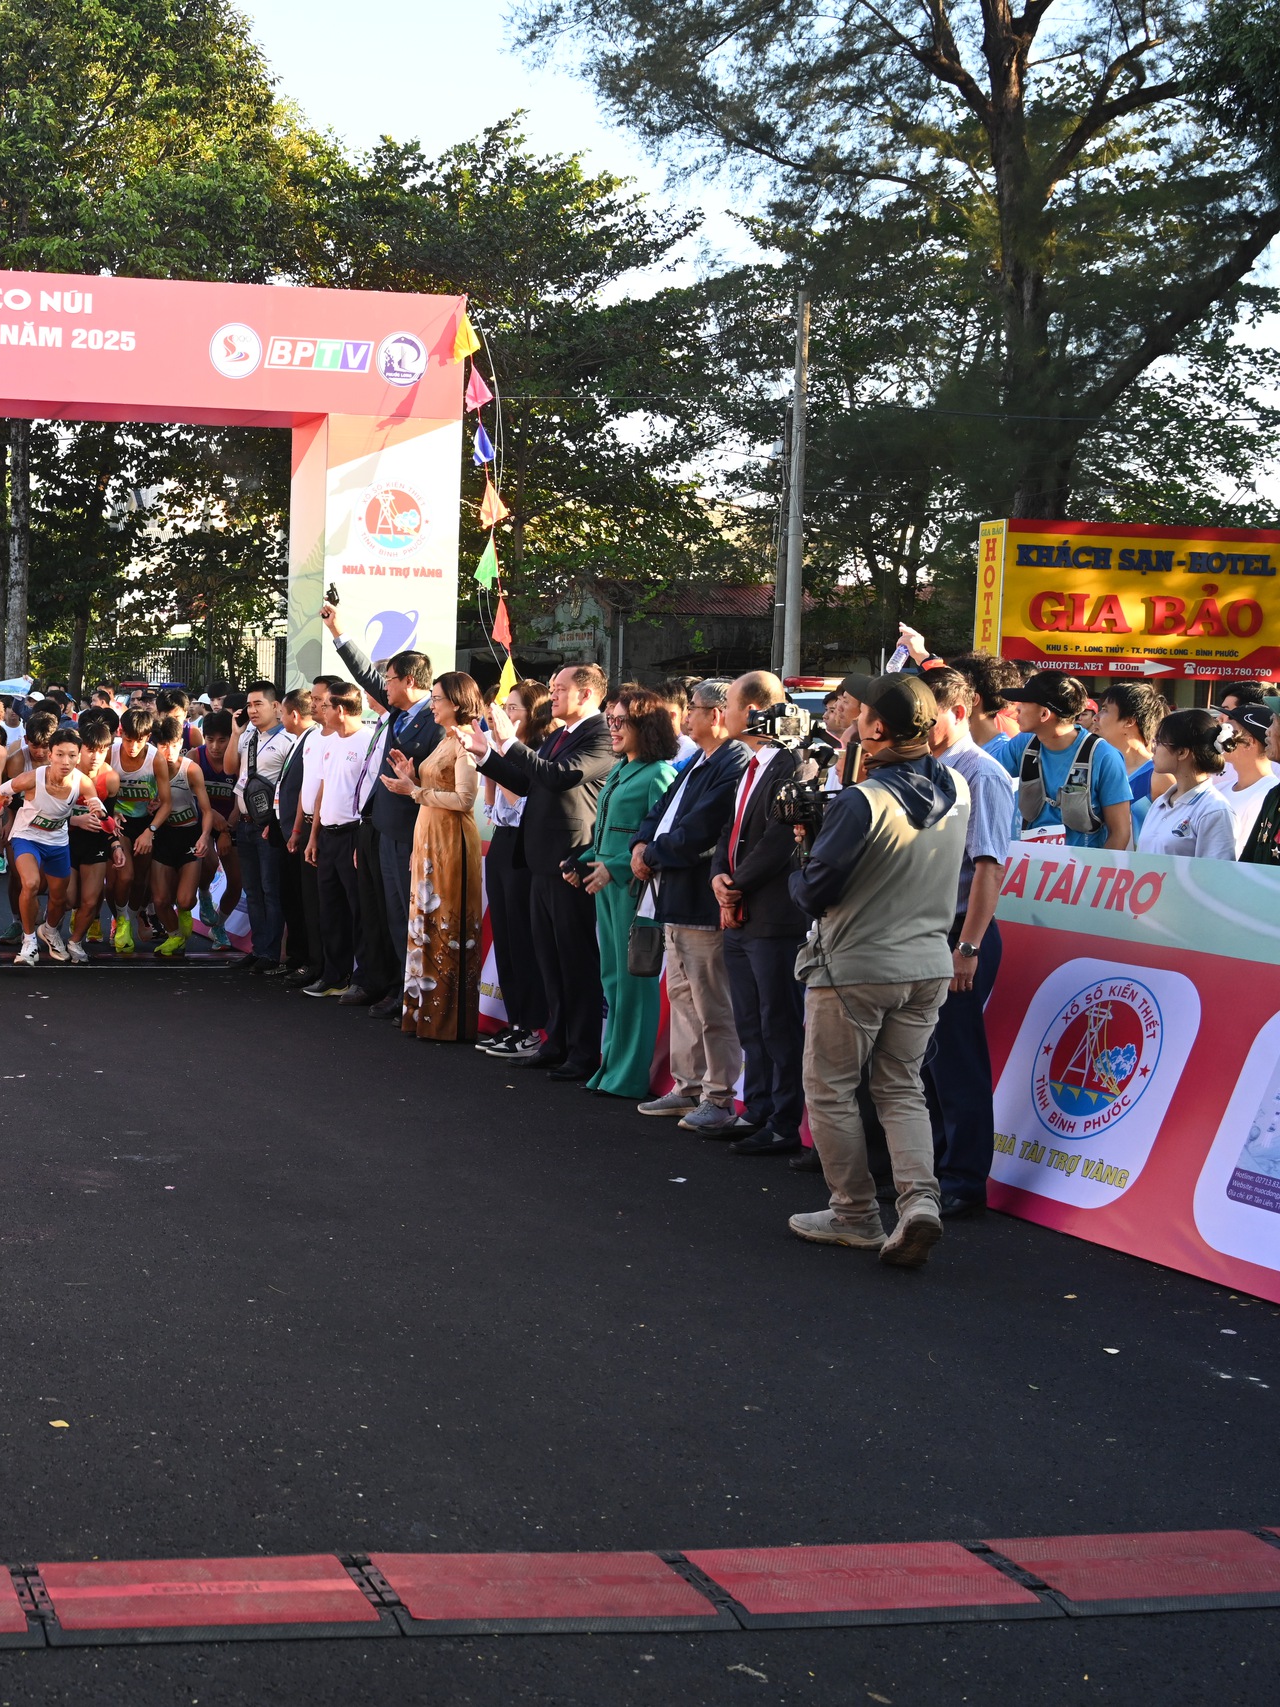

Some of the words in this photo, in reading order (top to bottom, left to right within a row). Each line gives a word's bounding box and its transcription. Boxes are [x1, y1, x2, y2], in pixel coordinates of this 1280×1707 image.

[39, 289, 93, 315] NÚI
[0, 321, 63, 348] NĂM
[71, 327, 137, 352] 2025
[269, 339, 371, 370] BPTV
[980, 528, 991, 537] GIA
[1016, 540, 1113, 571] KHÁCH
[342, 564, 366, 576] NHÀ
[369, 564, 386, 577] TÀI
[388, 566, 411, 579] TRỢ
[413, 565, 443, 579] VÀNG
[981, 537, 998, 652] HOTE
[1029, 590, 1133, 634] GIA
[1146, 583, 1265, 639] BẢO
[1046, 644, 1062, 652] KHU
[1084, 645, 1104, 653] LONG
[1169, 648, 1189, 656] LONG
[1195, 648, 1213, 657] BÌNH
[1114, 663, 1140, 671] 100m
[1196, 665, 1272, 677] (0271)3.780.790
[1033, 858, 1093, 906] TÀI
[1089, 866, 1168, 920] TRỢ
[1061, 999, 1080, 1025] XỔ
[1085, 983, 1104, 1005] SỐ
[1108, 982, 1139, 1002] KIẾN
[1137, 997, 1161, 1040] THIẾT
[1047, 1111, 1077, 1134] BÌNH
[1083, 1094, 1132, 1133] PHƯỚC
[1018, 1140, 1047, 1164] TÀI
[1046, 1147, 1083, 1178] TRỢ
[1081, 1158, 1131, 1190] VÀNG
[1254, 1175, 1280, 1189] 02713.83
